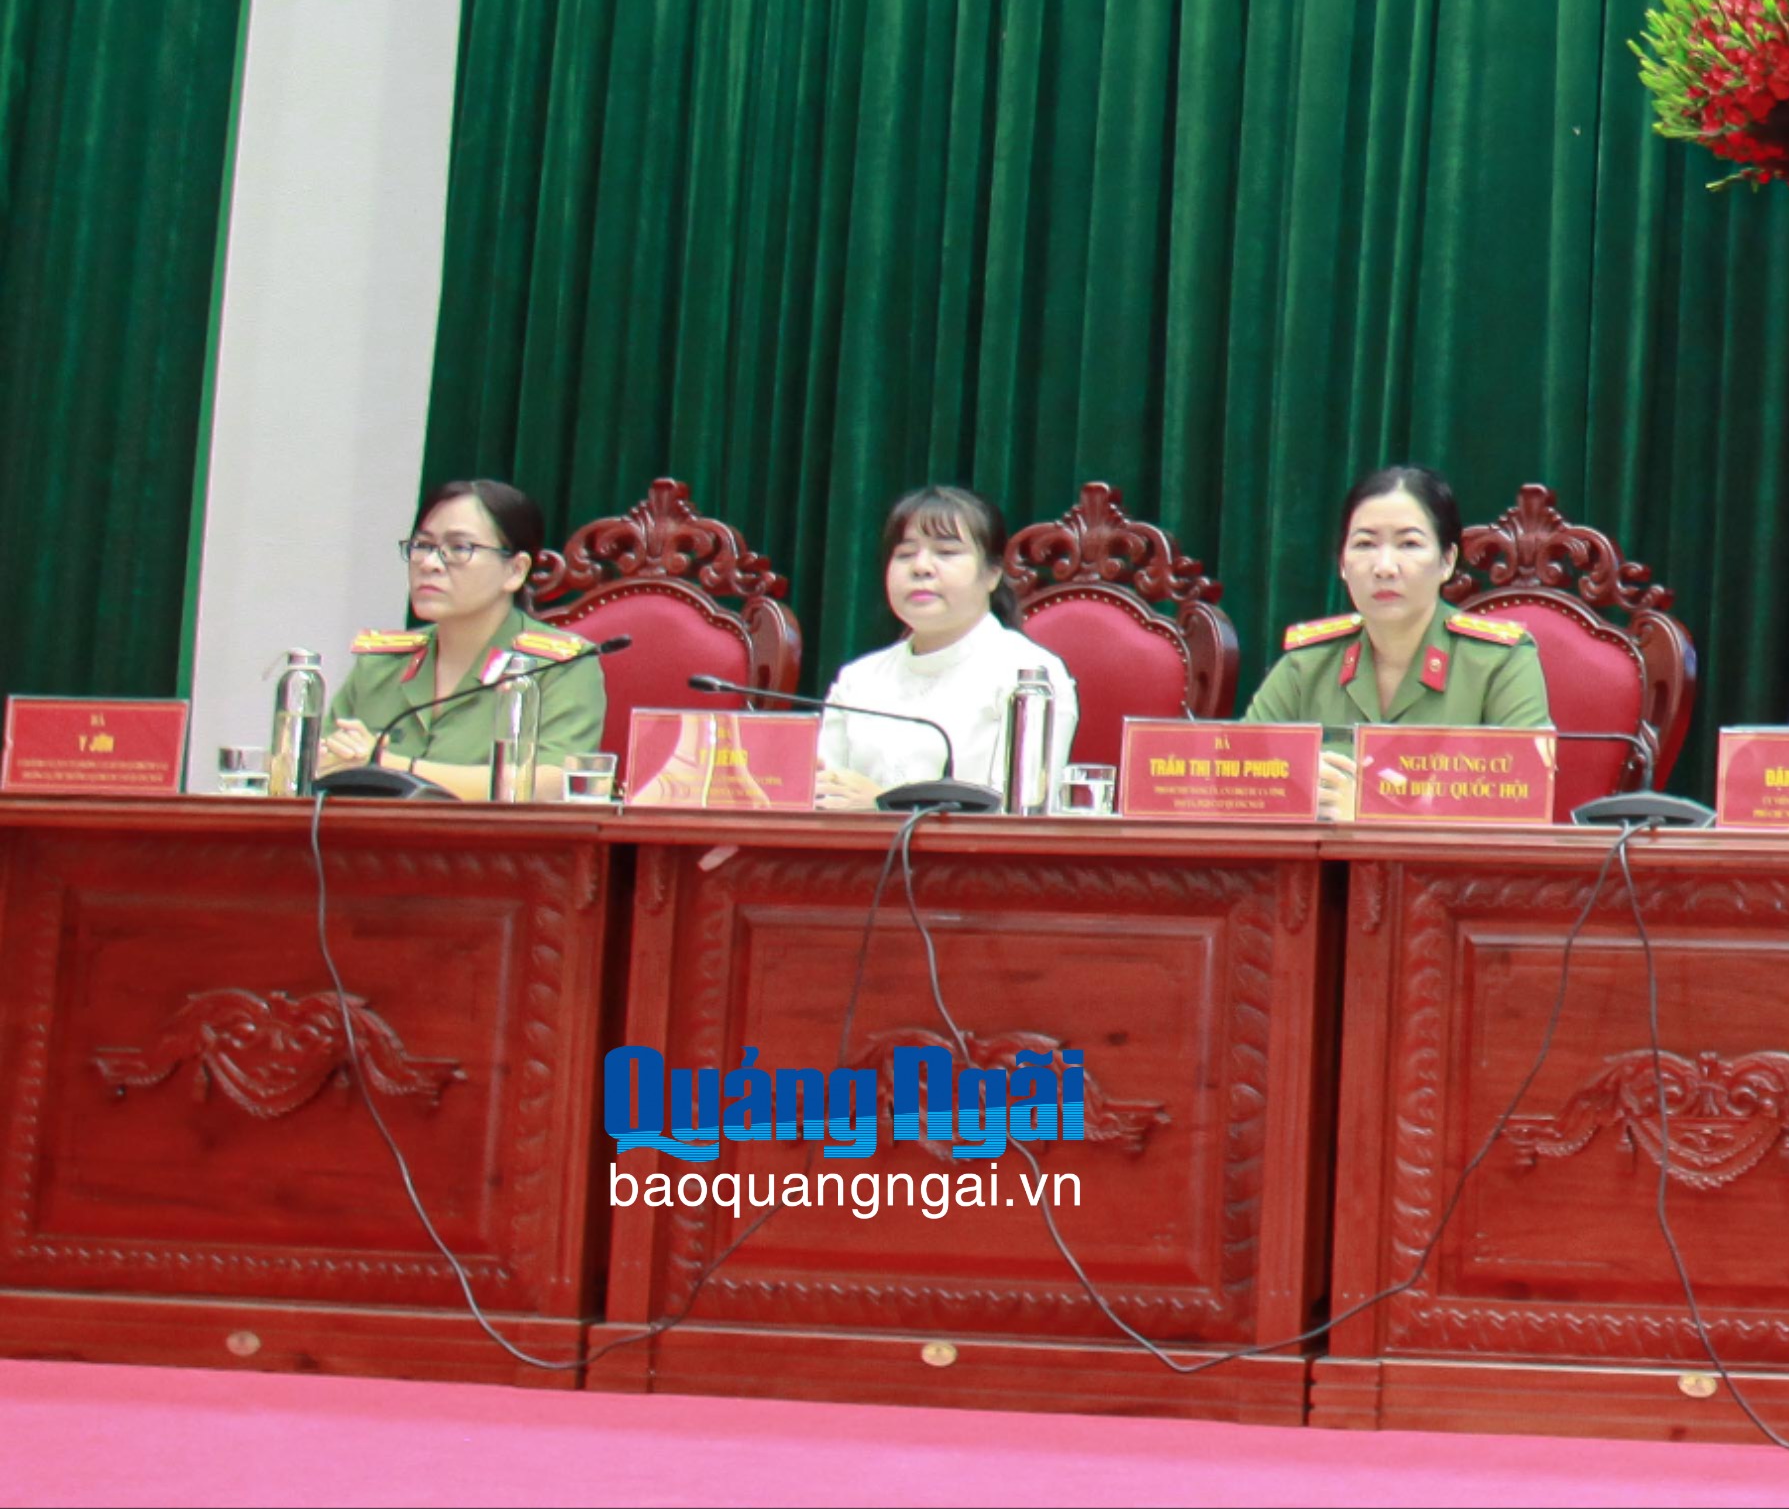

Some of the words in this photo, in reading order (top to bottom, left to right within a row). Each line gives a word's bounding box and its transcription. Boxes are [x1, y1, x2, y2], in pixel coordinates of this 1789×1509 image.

[1214, 759, 1240, 778] THU
[1450, 776, 1495, 801] QUỐC
[1500, 779, 1529, 802] HỘI
